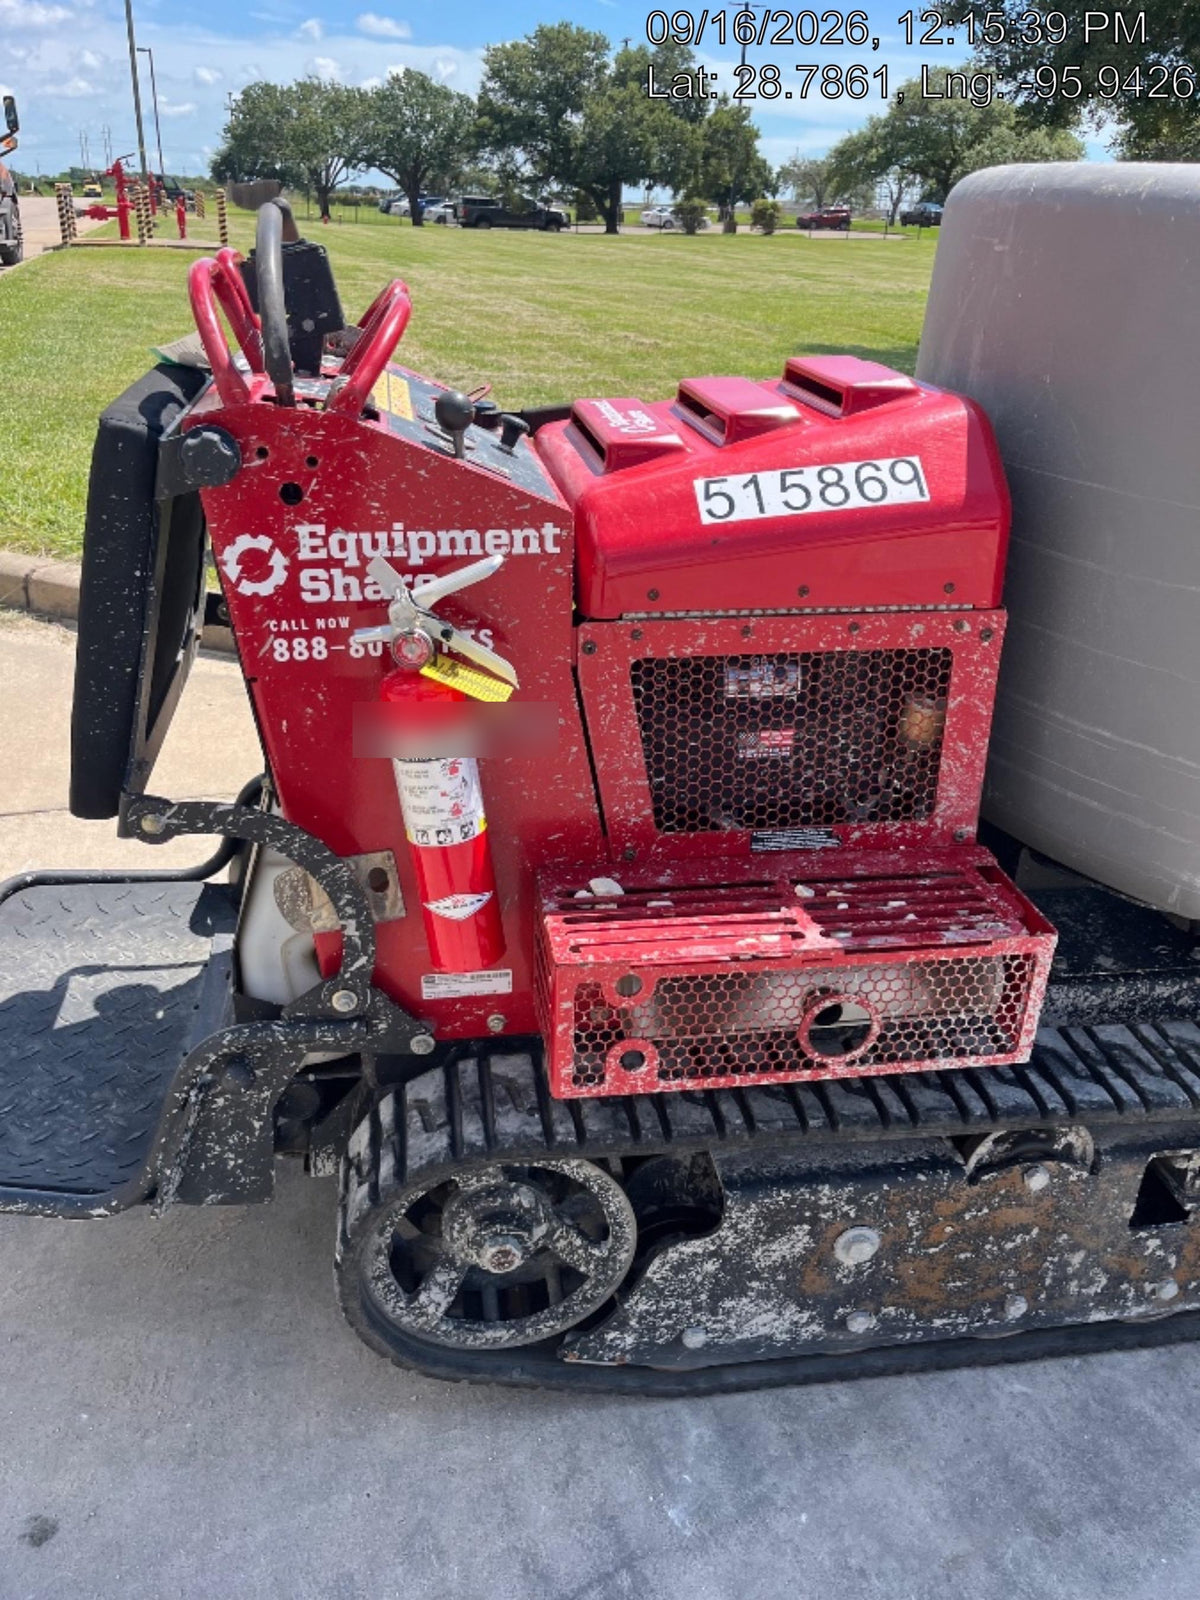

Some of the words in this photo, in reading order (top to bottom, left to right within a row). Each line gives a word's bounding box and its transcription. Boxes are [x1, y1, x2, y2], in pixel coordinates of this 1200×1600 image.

[703, 457, 927, 521] 515869
[295, 522, 561, 568] Equipment
[269, 618, 310, 632] CALL
[316, 616, 351, 630] NOW
